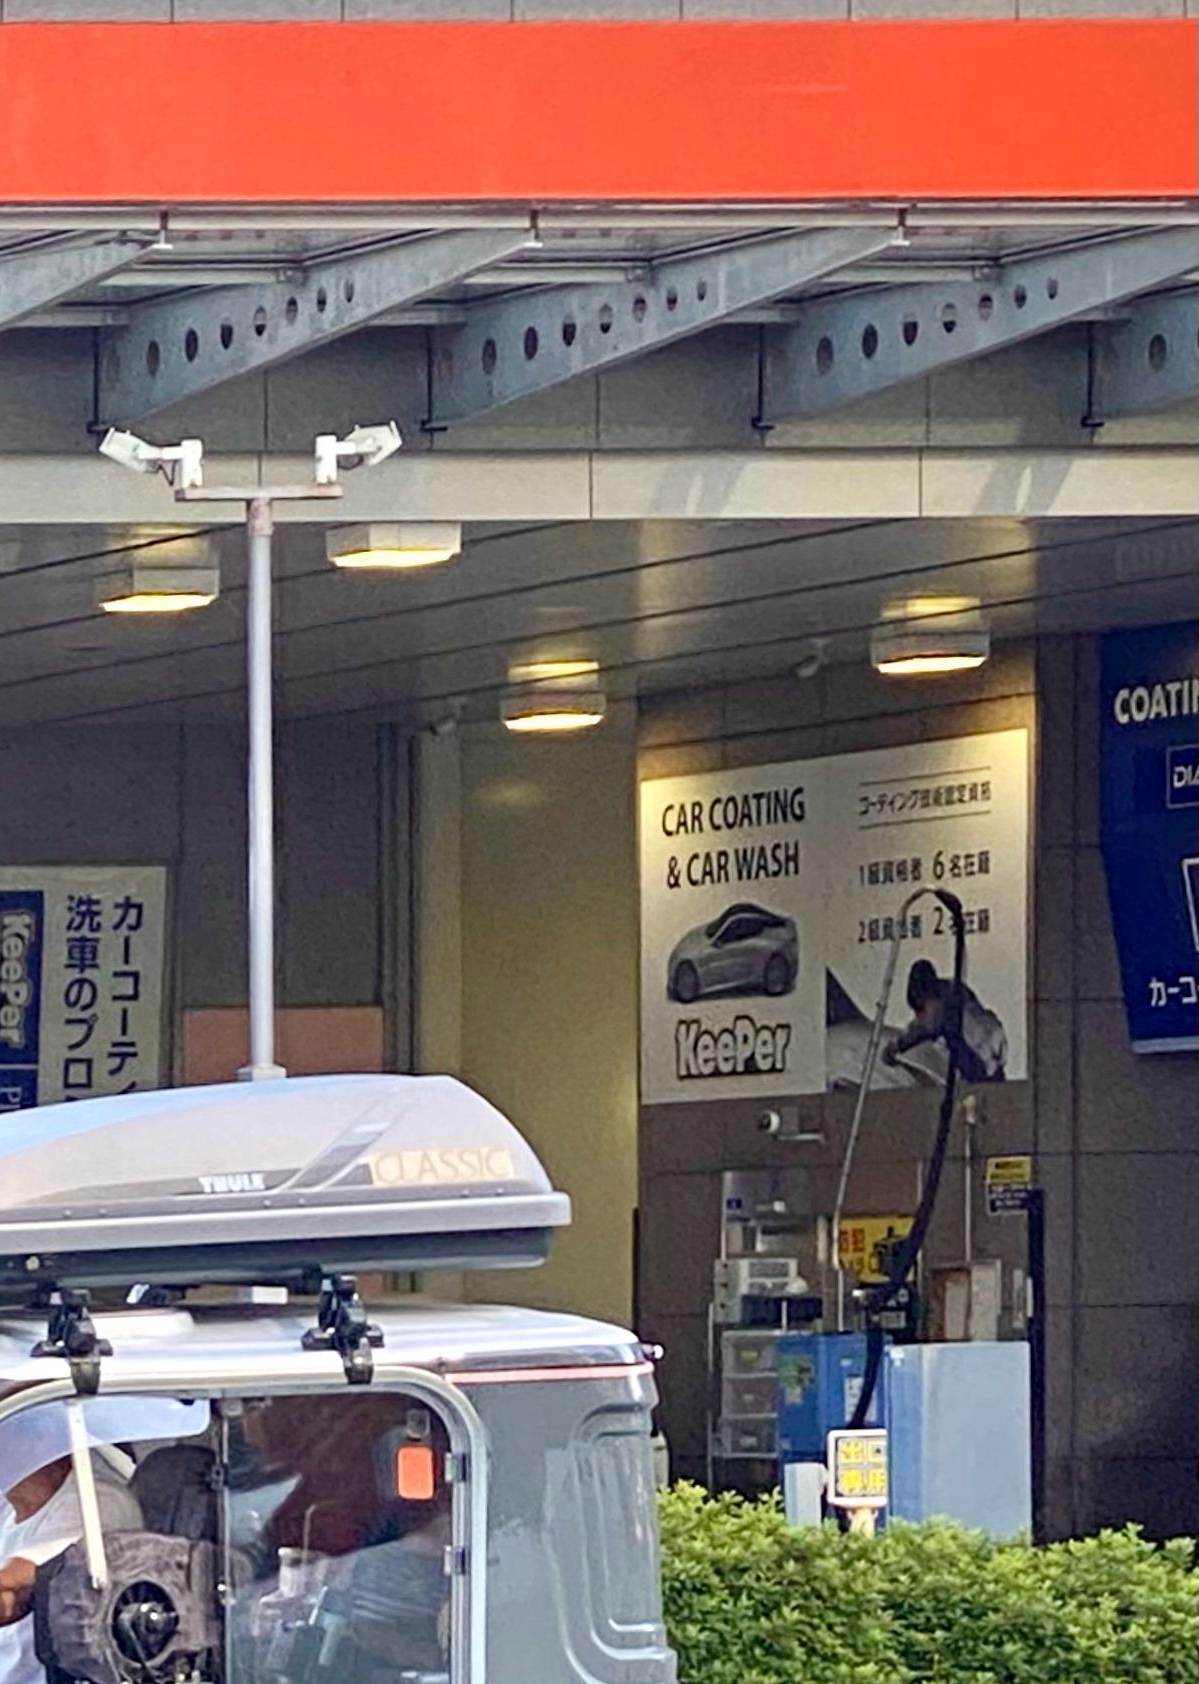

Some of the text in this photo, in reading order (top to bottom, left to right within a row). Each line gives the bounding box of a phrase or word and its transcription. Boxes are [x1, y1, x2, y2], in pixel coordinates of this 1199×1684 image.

[662, 787, 805, 836] CAR COATING
[667, 839, 799, 889] & CAR WASH
[0, 911, 34, 1047] KeePer
[63, 894, 102, 1101] 洗車のプロ
[1149, 976, 1199, 1007] カーコ
[675, 1014, 791, 1080] KeePer
[198, 1173, 265, 1193] THULE
[375, 1147, 511, 1184] CLASSIC
